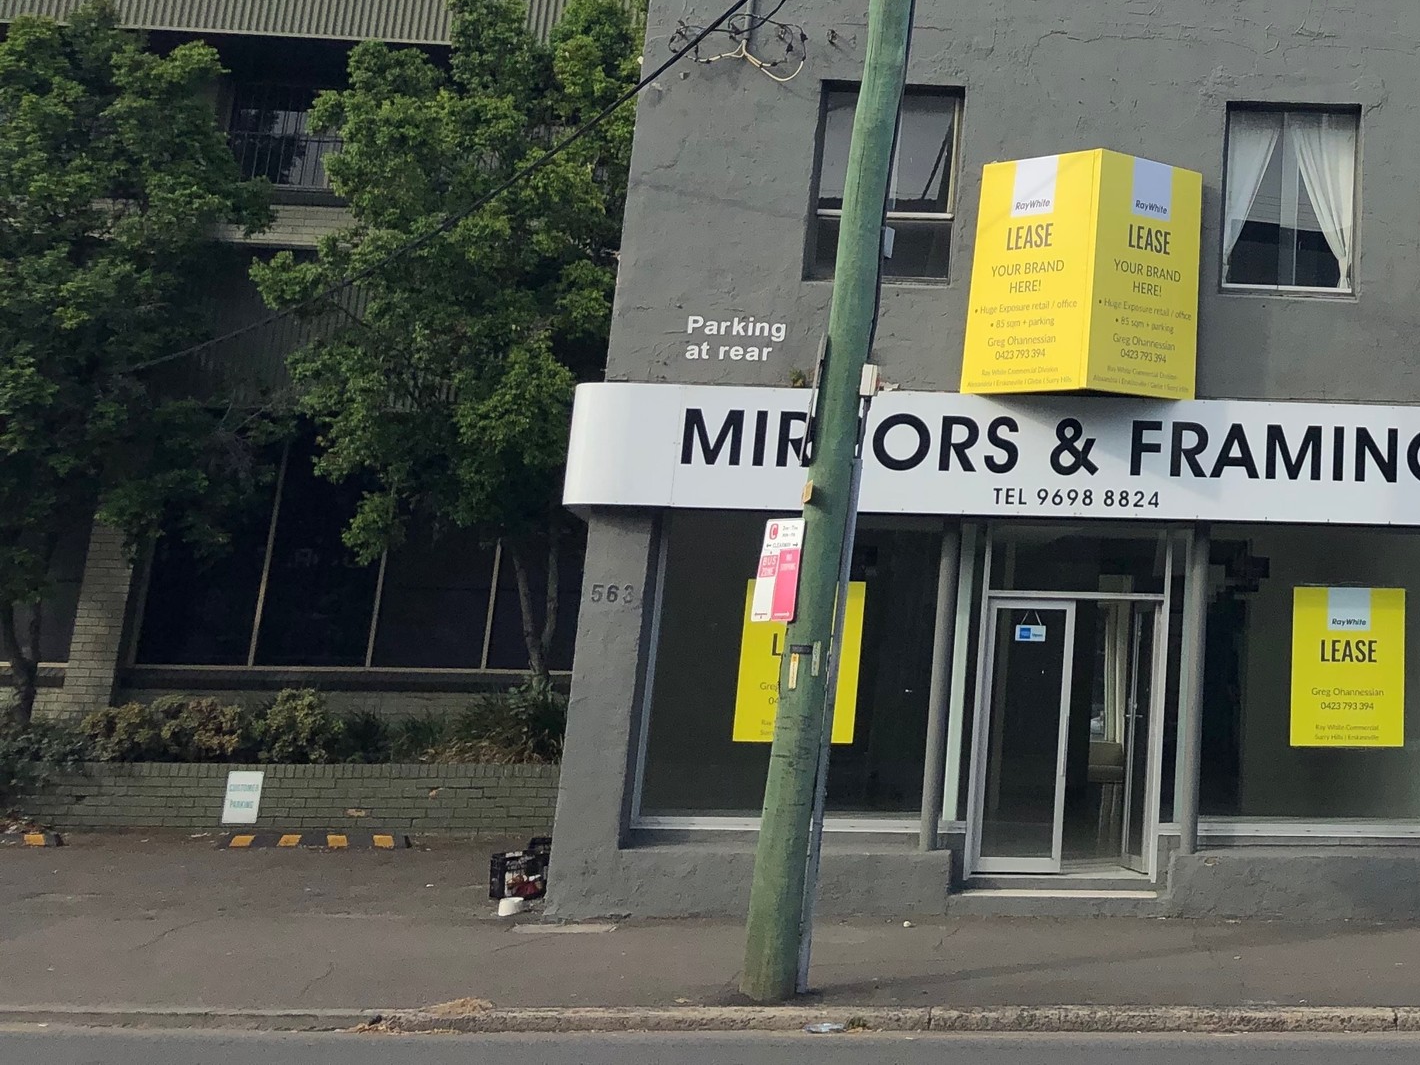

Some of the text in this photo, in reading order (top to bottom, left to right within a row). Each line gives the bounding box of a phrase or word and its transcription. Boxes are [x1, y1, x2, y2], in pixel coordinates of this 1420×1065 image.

[1006, 223, 1054, 251] LEASE
[1128, 223, 1171, 255] LEASE
[991, 260, 1065, 277] YOUR BRAND
[1114, 258, 1181, 282] YOUR BRAND
[1009, 280, 1042, 294] HERE!
[1132, 281, 1162, 297] HERE!
[980, 305, 998, 315] Huge
[999, 303, 1030, 313] Exposure
[1031, 301, 1050, 310] retail
[1057, 299, 1078, 308] office
[1104, 298, 1121, 308] Huge
[1123, 301, 1153, 314] Exposure
[1153, 308, 1169, 317] retail
[996, 320, 1005, 329] 85
[1006, 320, 1020, 329] sqm
[1028, 317, 1055, 328] parking
[1121, 316, 1129, 325] 85
[687, 315, 787, 343] Parking
[988, 334, 1056, 348] Greg Ohannessian
[1113, 333, 1175, 351] Greg Ohannessian
[685, 342, 773, 362] at rear
[995, 348, 1046, 360] 0423 793 394
[1120, 348, 1166, 363] 0423 793 394
[680, 408, 1019, 474] MIRORS
[1050, 417, 1099, 476] &
[993, 487, 1160, 509] TEL 9698 8824
[763, 556, 777, 566] BUS
[590, 583, 635, 605] 563
[1331, 618, 1367, 626] RayWhite
[1320, 639, 1378, 663] LEASE
[1311, 687, 1384, 697] Greg Ohannessian
[1320, 702, 1374, 711] 0423 793 394
